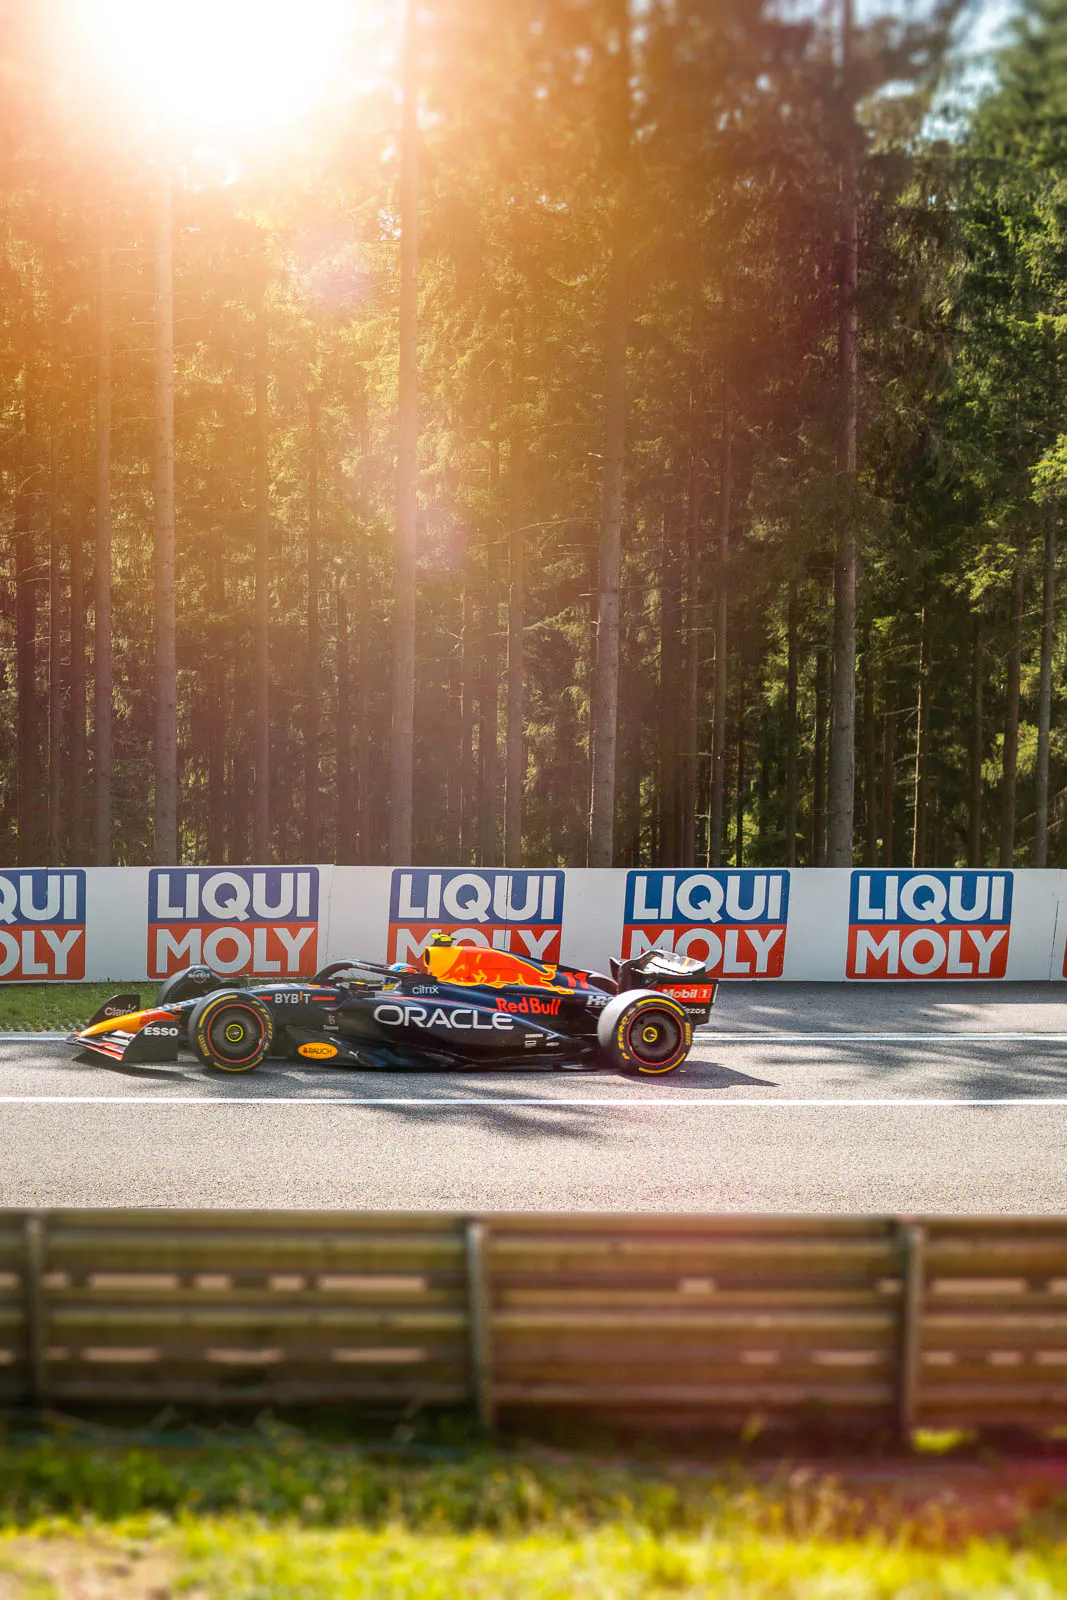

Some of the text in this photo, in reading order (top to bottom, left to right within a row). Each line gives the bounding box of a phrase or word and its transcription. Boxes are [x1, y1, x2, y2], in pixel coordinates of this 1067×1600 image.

[157, 872, 311, 921] LIQUI
[398, 873, 557, 923] LIQUI
[633, 874, 783, 923] LIQUI
[857, 874, 1006, 924] LIQUI
[156, 926, 316, 974] MOLY
[854, 928, 1008, 975] MOLY
[274, 991, 311, 1004] BYBIT
[412, 985, 439, 995] citrix
[662, 988, 708, 999] Mobil 1
[143, 1027, 179, 1036] ESSO
[373, 1004, 514, 1030] ORACLE
